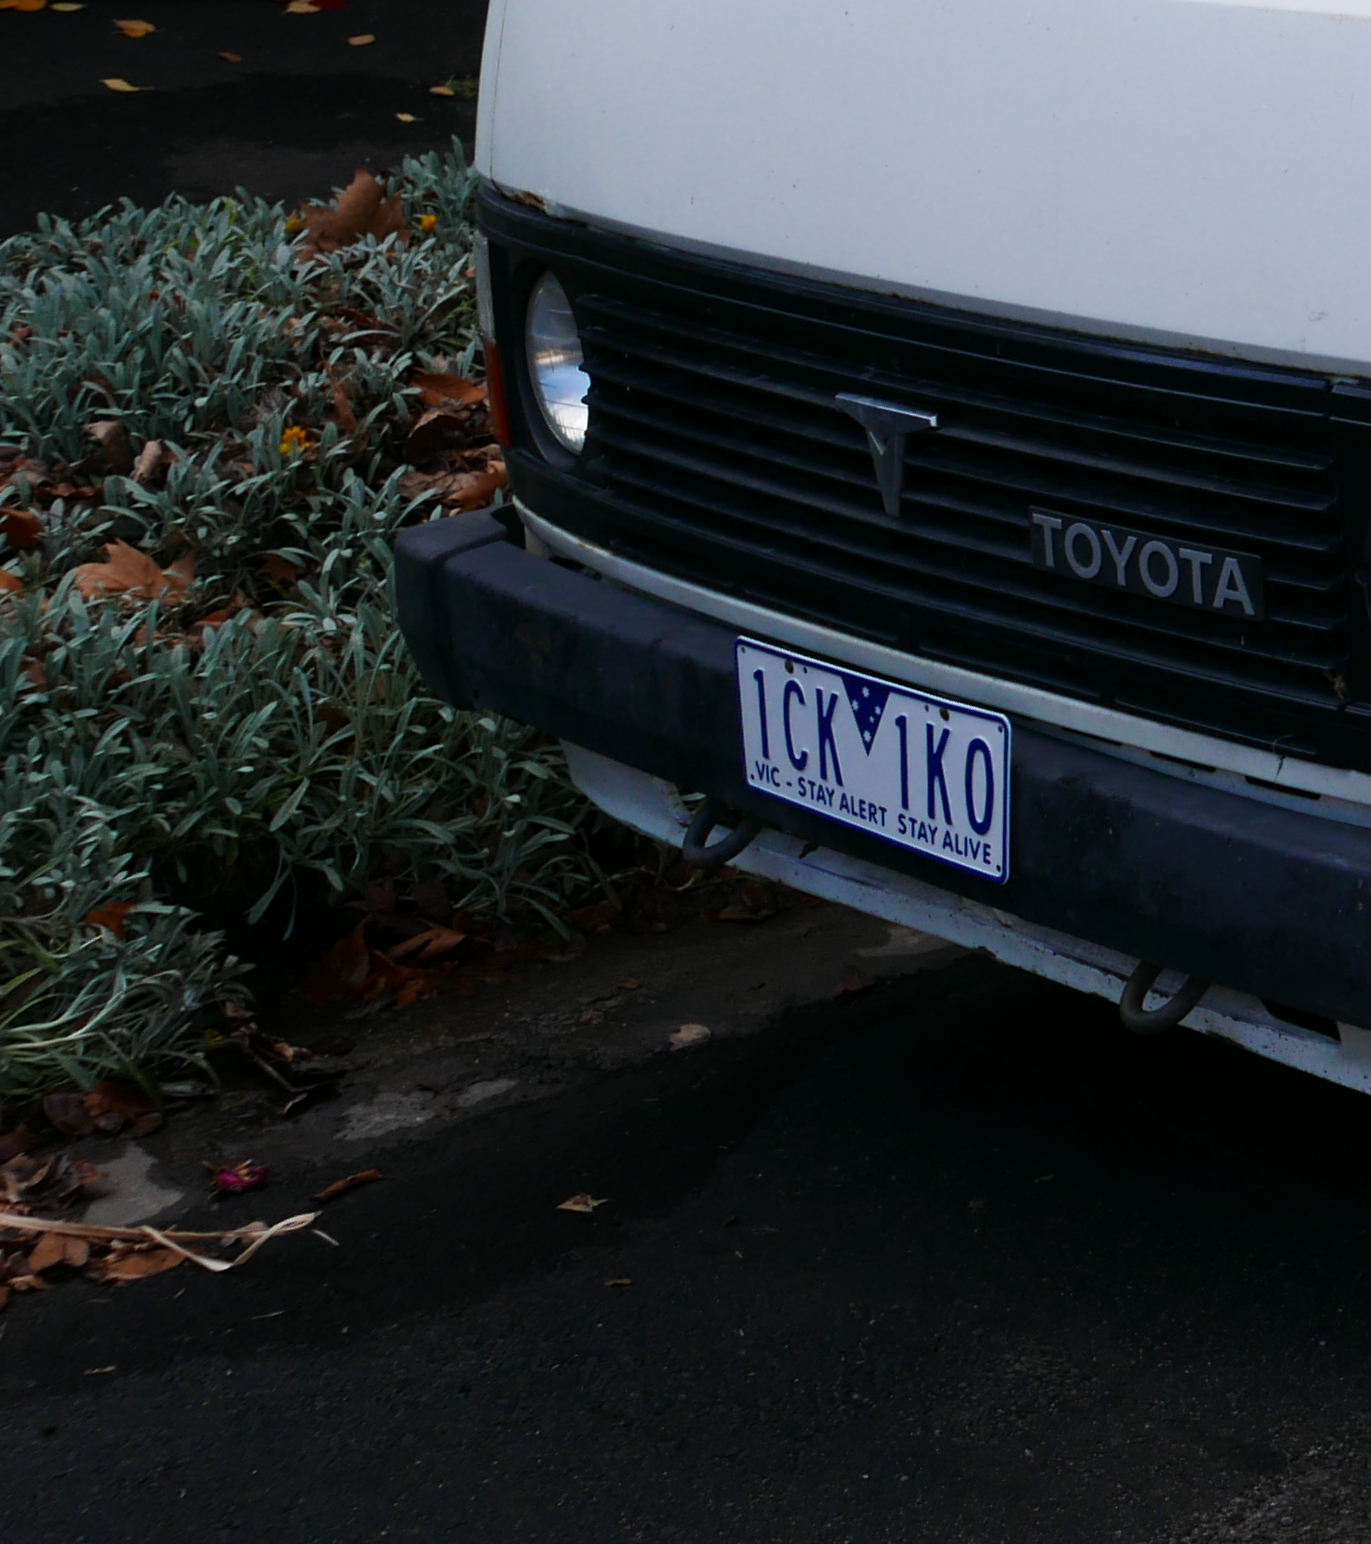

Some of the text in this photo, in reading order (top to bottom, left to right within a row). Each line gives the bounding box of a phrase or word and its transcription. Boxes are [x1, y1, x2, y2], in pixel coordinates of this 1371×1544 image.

[1032, 513, 1255, 616] TOYOTA
[753, 667, 994, 835] 1CK 1KO
[755, 760, 781, 788] VIC
[797, 776, 835, 807] STAY
[839, 792, 888, 827] ALERT
[898, 813, 938, 845] STAY
[942, 830, 991, 864] ALIVE
